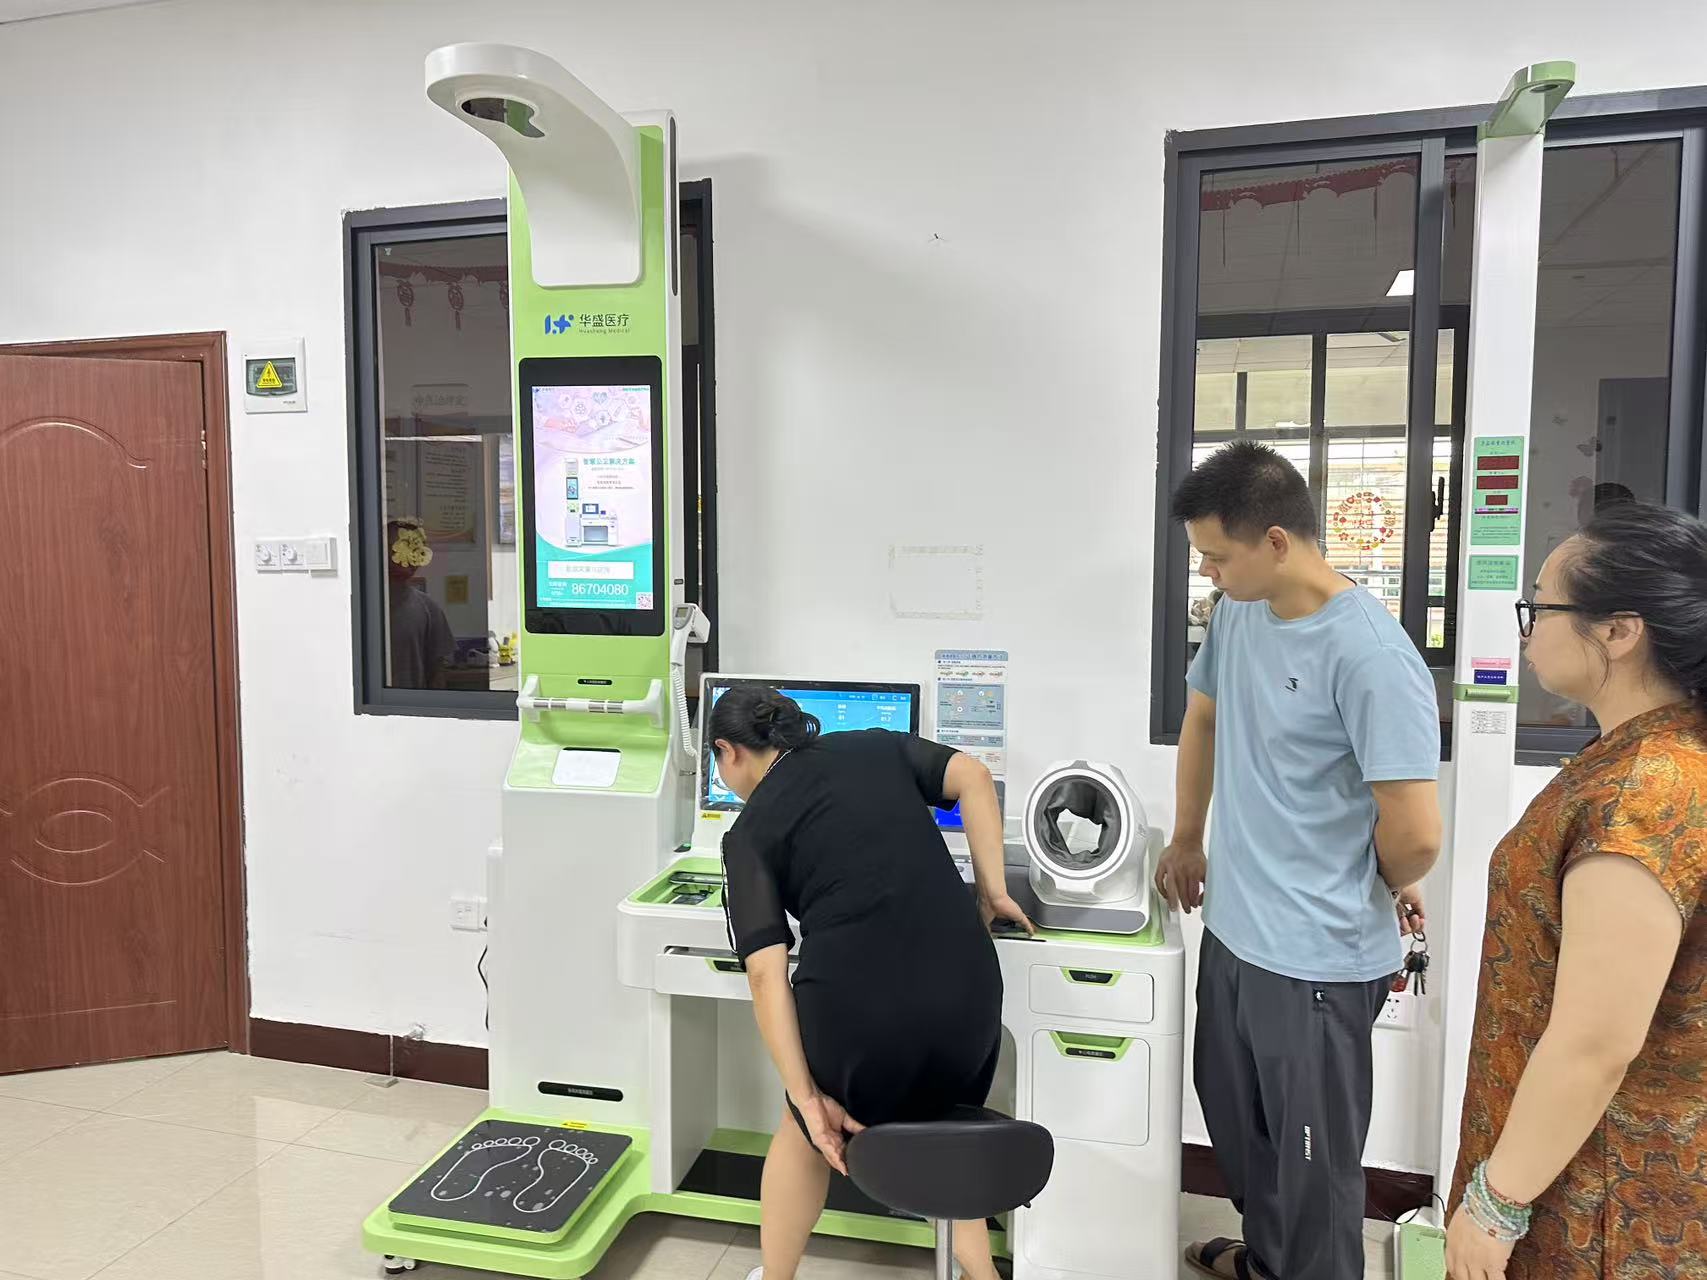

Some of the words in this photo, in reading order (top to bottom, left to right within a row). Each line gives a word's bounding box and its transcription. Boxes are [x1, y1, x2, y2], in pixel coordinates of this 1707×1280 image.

[579, 313, 629, 327] 华盛医疗
[571, 584, 629, 595] 86704080
